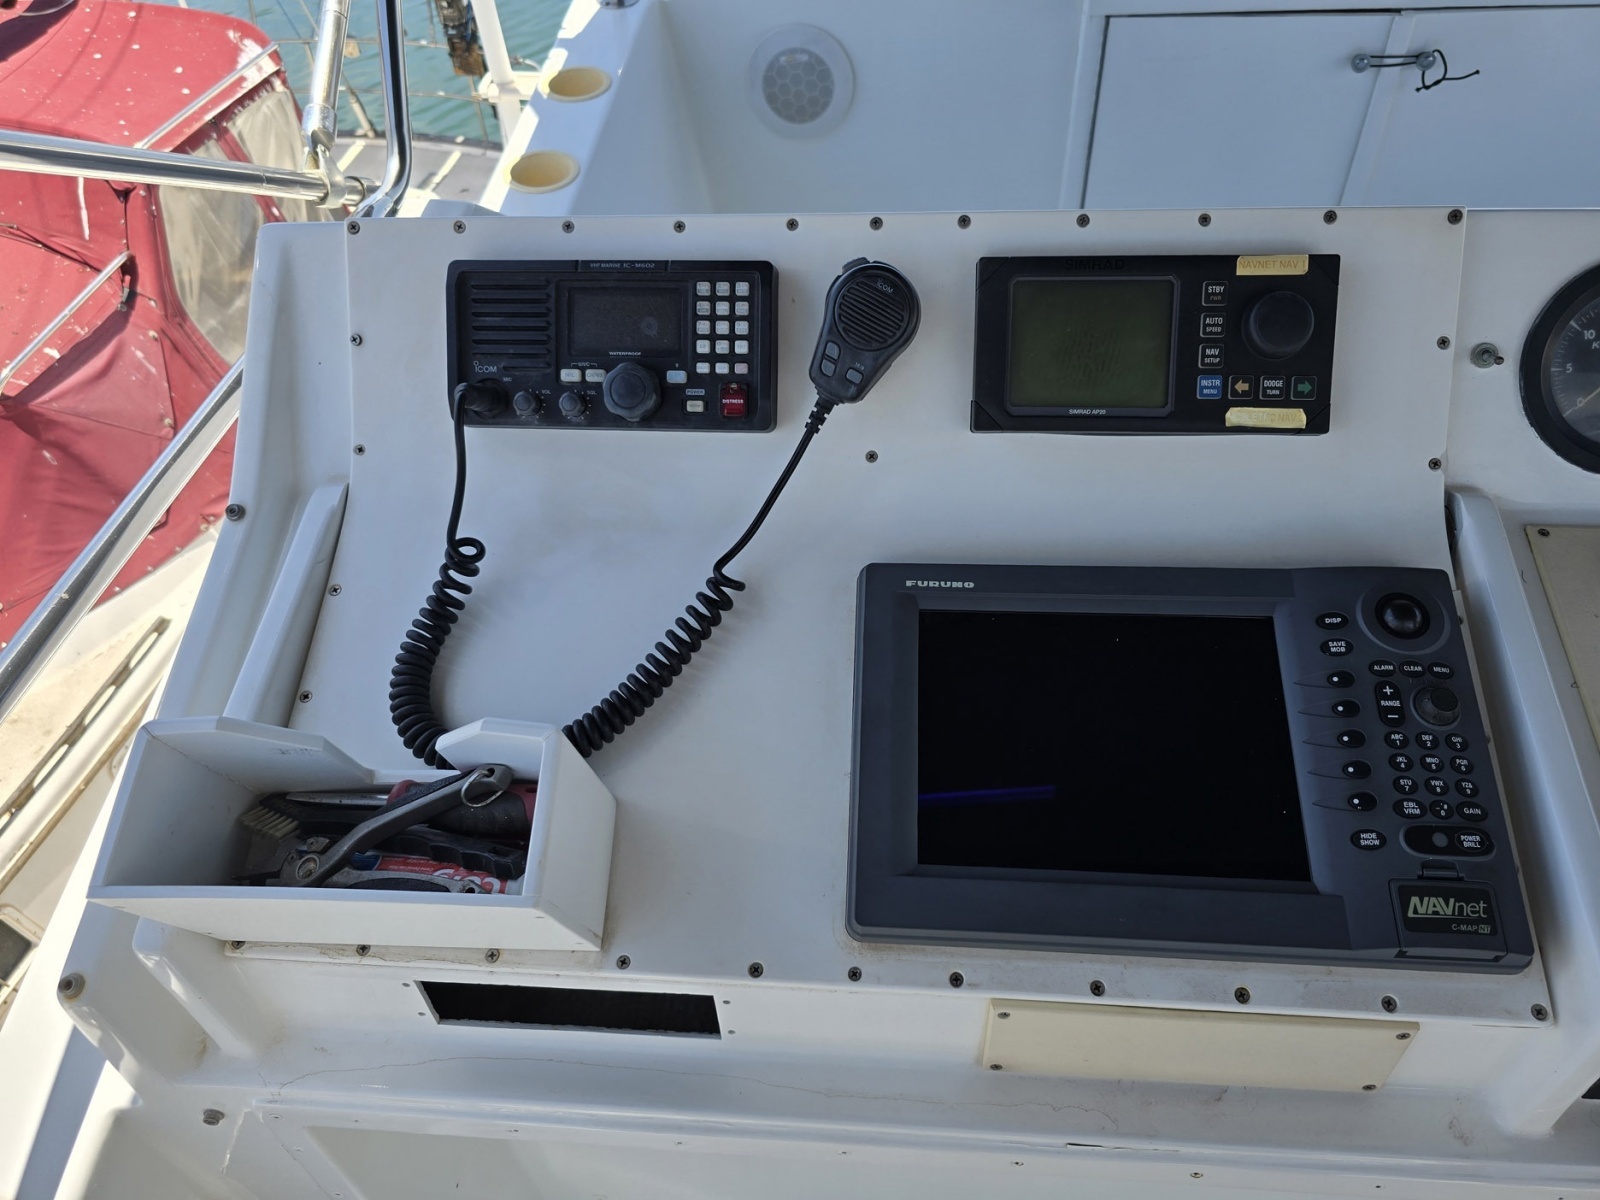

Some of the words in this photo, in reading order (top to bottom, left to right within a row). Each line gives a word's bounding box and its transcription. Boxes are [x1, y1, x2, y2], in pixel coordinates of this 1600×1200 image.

[1064, 258, 1125, 270] SIMRAD
[1240, 260, 1276, 269] NAVNET
[1280, 260, 1298, 269] NAV
[1205, 317, 1223, 325] AUTO
[1583, 329, 1596, 340] 10
[1565, 363, 1573, 374] 5
[905, 580, 975, 588] FURUNO
[1463, 807, 1482, 816] GAIN
[1407, 896, 1488, 918] NAVnet
[1451, 924, 1478, 932] C-MAP
[1479, 925, 1490, 933] NT
